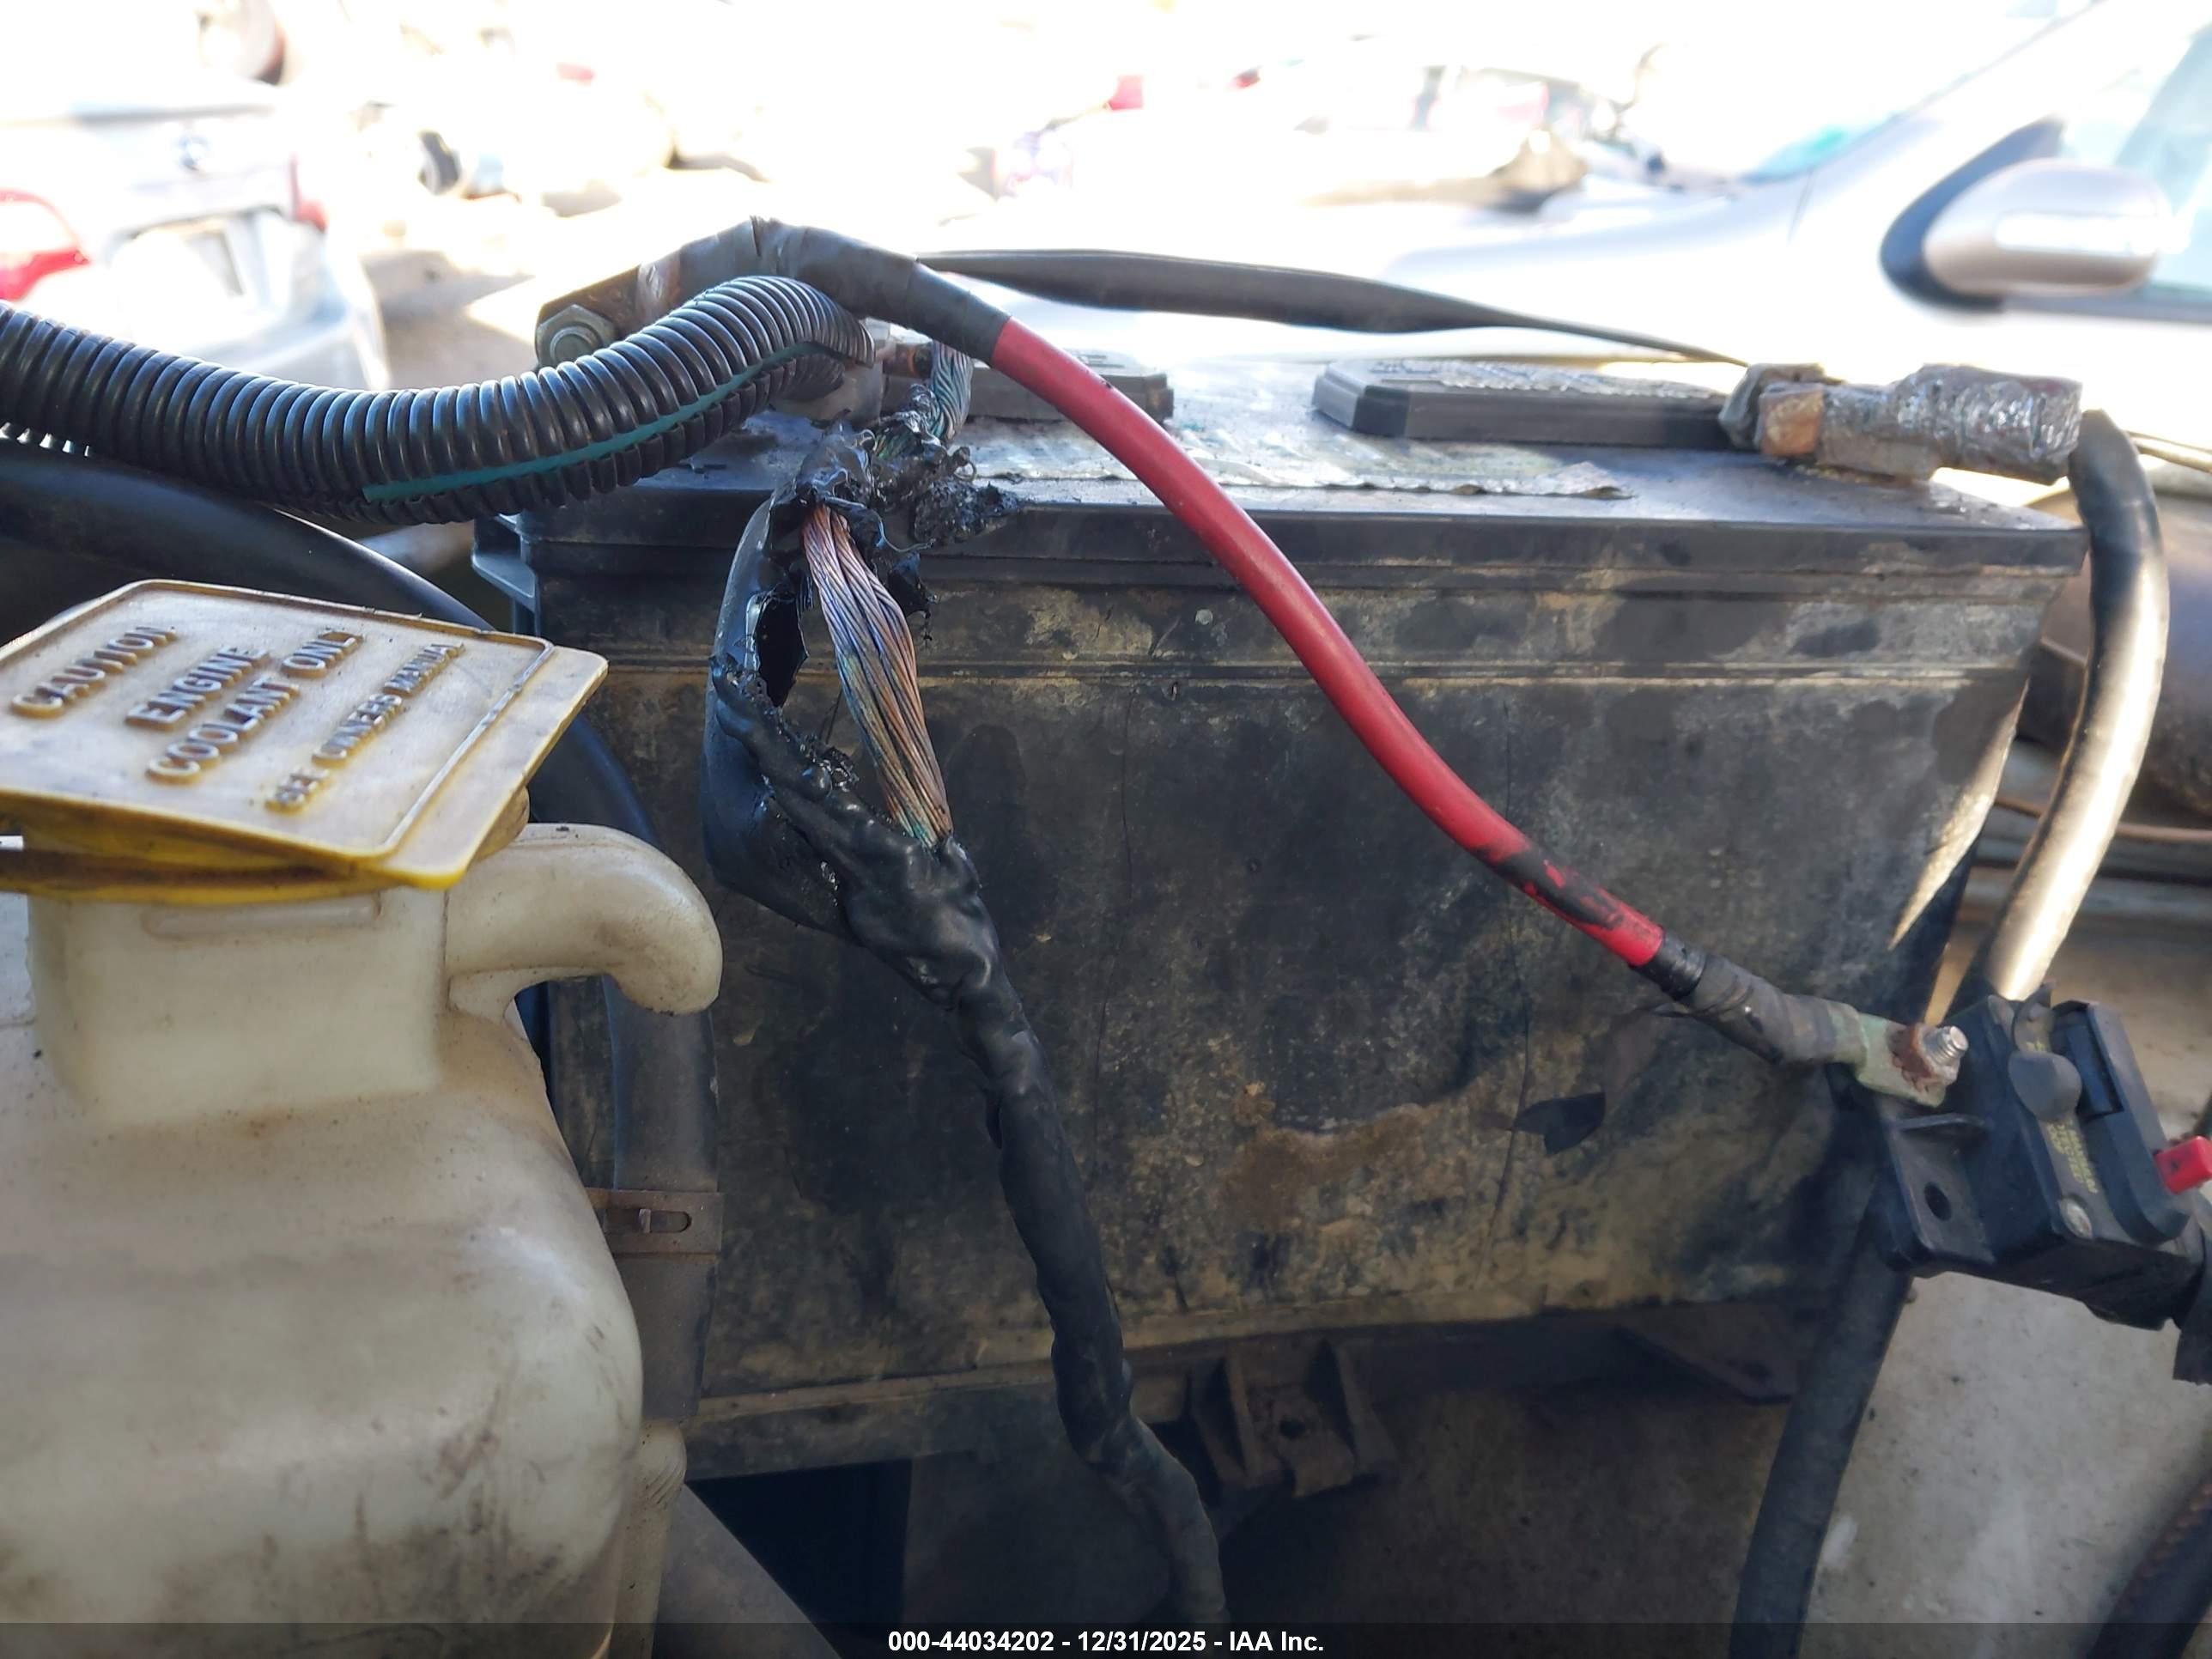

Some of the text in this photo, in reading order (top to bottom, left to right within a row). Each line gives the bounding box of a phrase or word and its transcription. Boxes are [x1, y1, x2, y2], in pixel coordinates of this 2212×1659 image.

[11, 625, 178, 718] CAUTION
[125, 646, 268, 728] ENGINE
[146, 673, 300, 783] COOLANT
